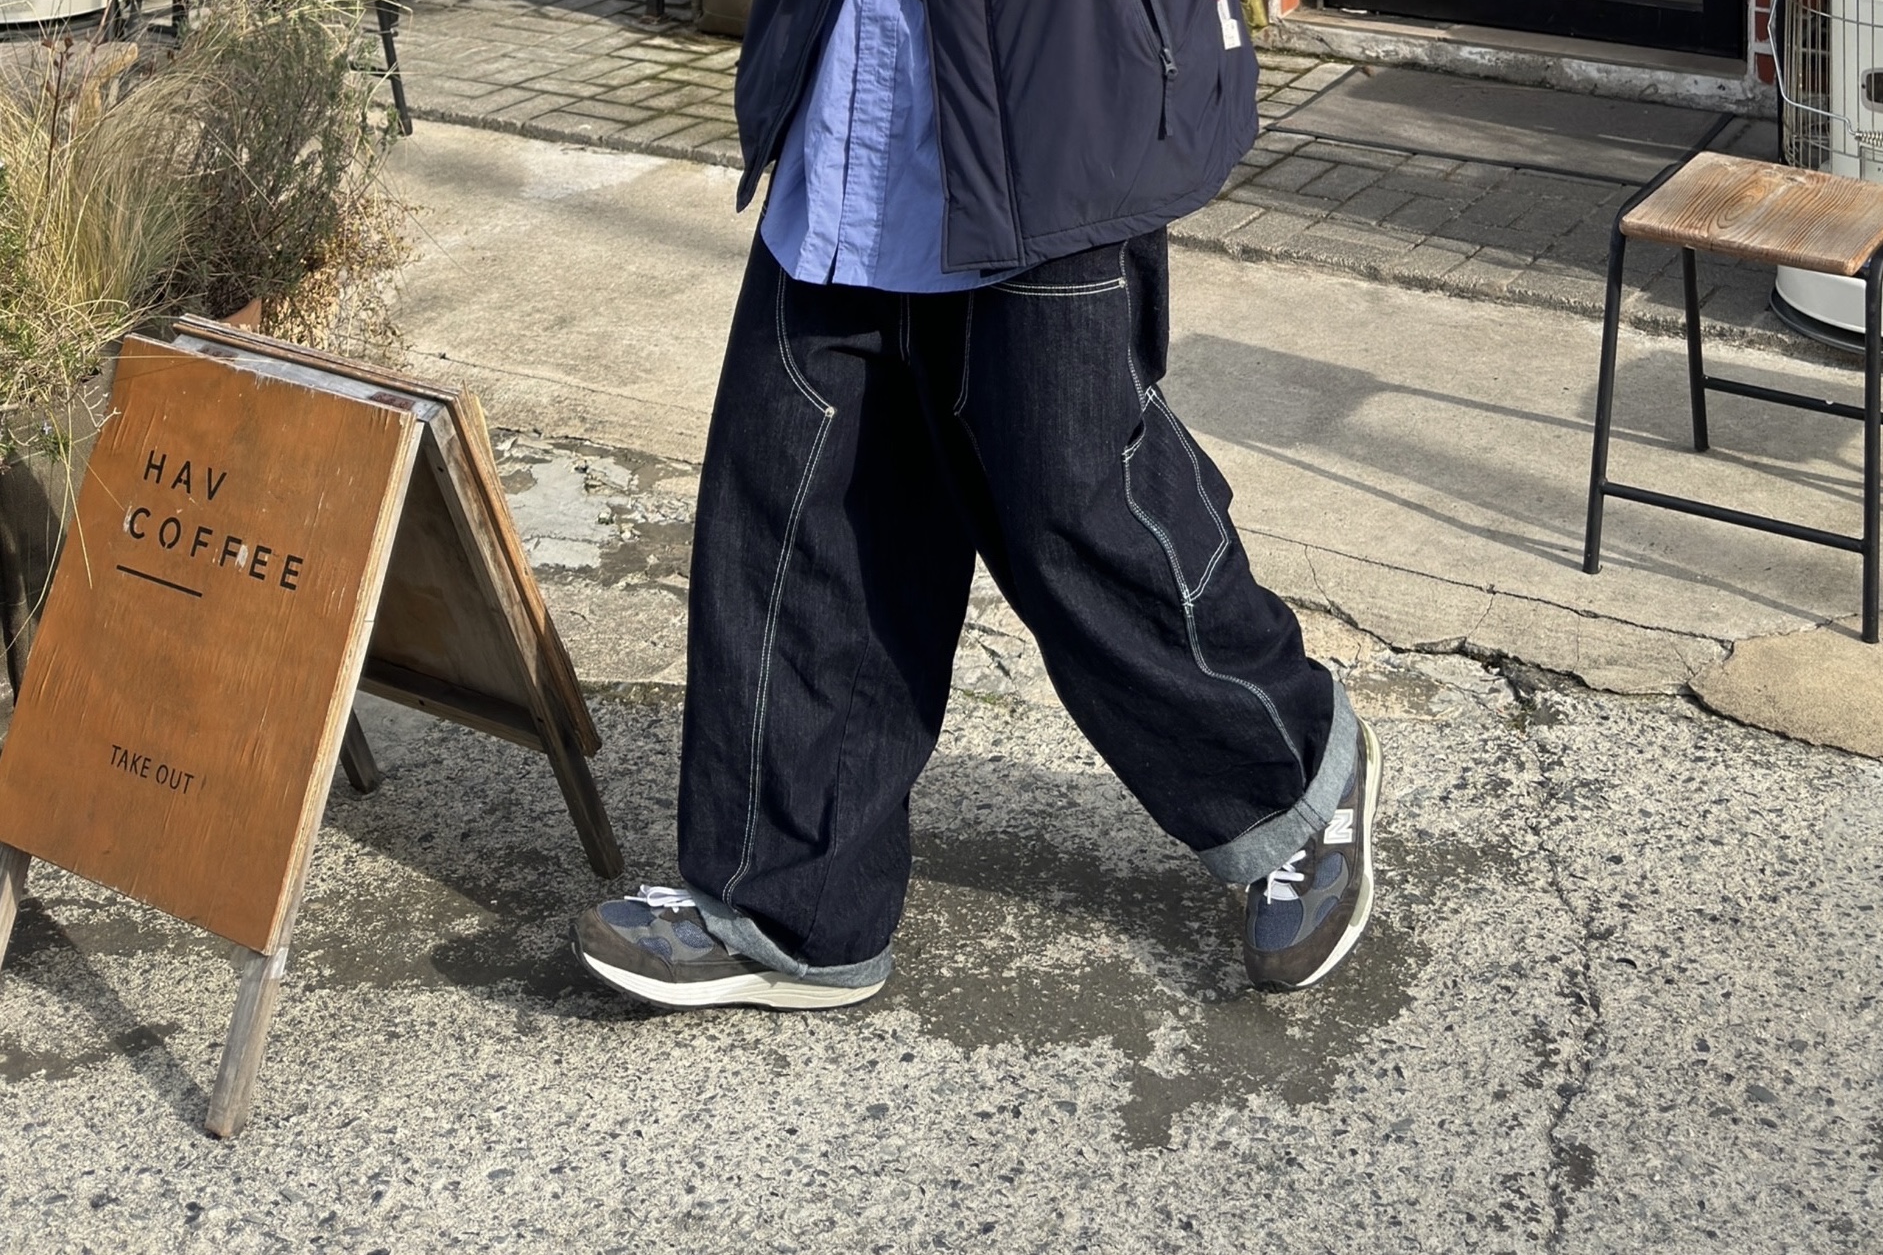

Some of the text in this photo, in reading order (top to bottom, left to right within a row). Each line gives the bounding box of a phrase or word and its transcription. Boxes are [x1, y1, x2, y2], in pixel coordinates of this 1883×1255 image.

[143, 450, 227, 500] HAV
[129, 507, 303, 591] COFFEE
[111, 744, 194, 794] TAKE OUT
[1323, 808, 1354, 844] N
